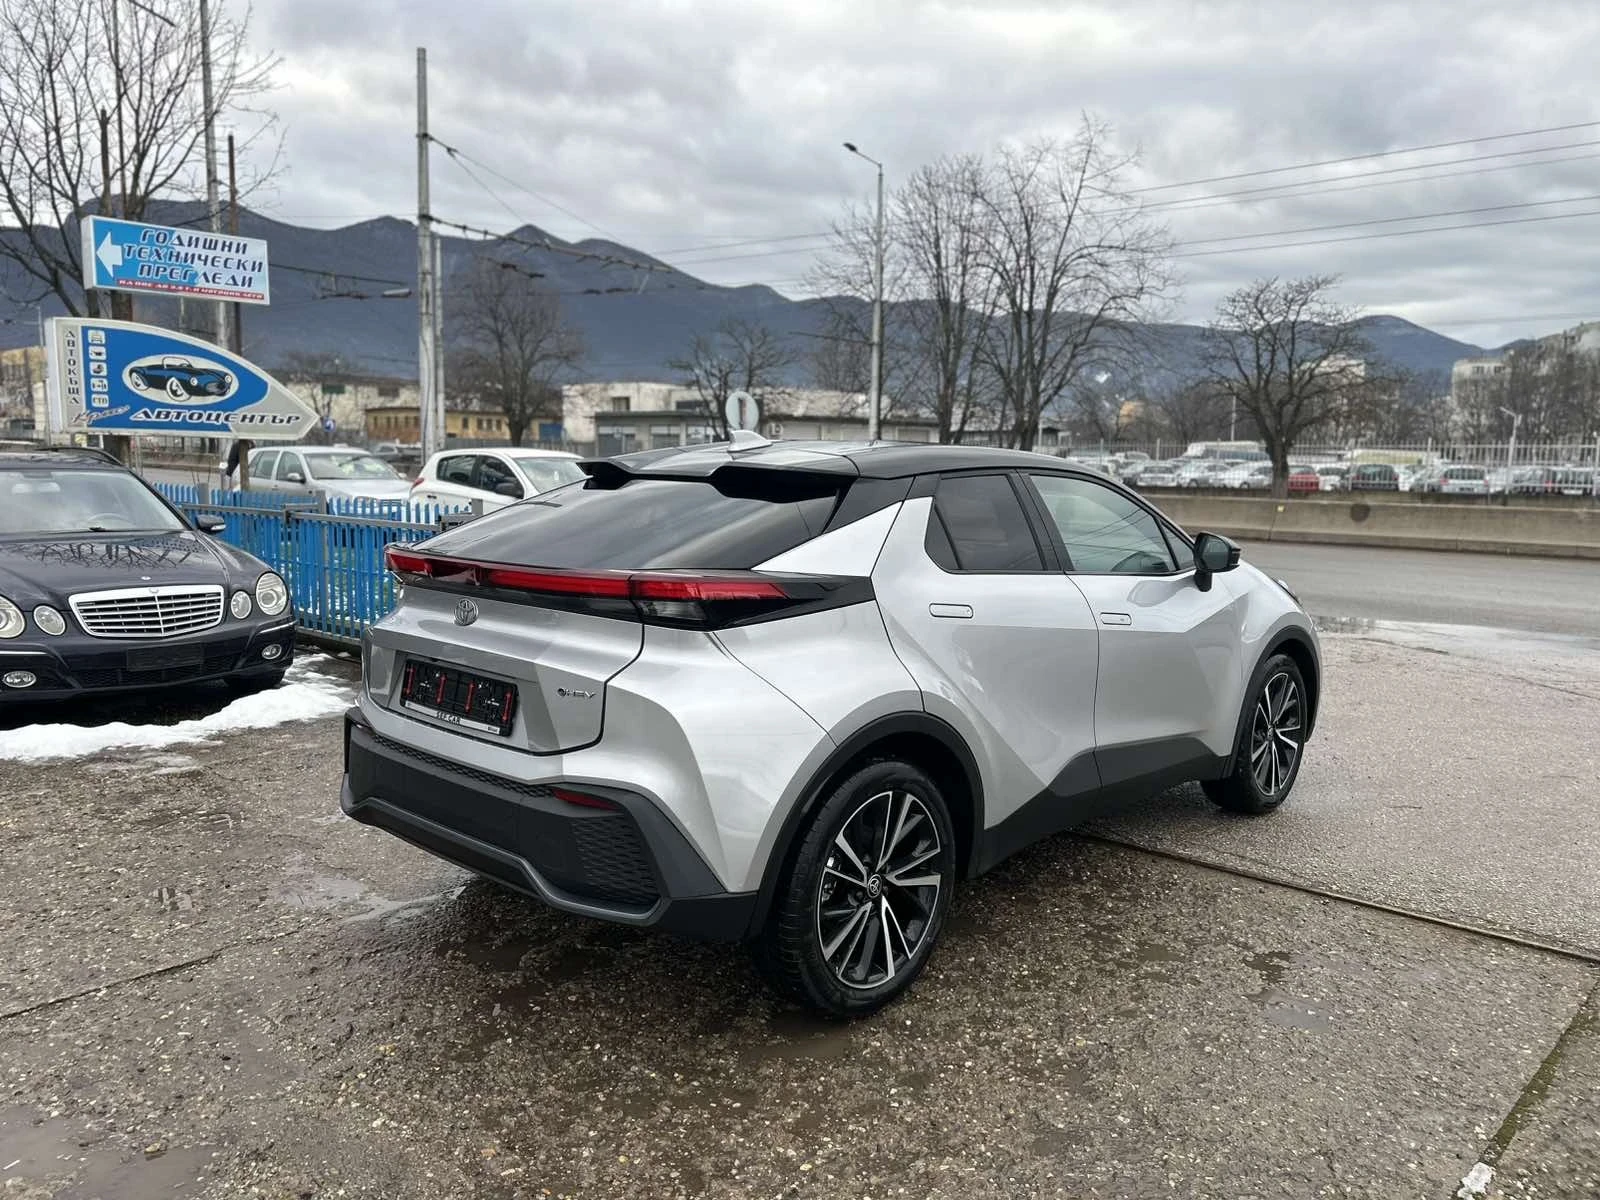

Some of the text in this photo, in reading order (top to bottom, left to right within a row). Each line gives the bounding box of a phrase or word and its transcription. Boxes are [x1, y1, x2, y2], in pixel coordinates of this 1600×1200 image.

[140, 229, 248, 255] ГОДИШНИ
[124, 244, 263, 273] ТЕХНИЧЕСКИ
[138, 262, 253, 288] ПРЕГЛЕДИ
[130, 408, 301, 426] АВТОЦЕНТЪР
